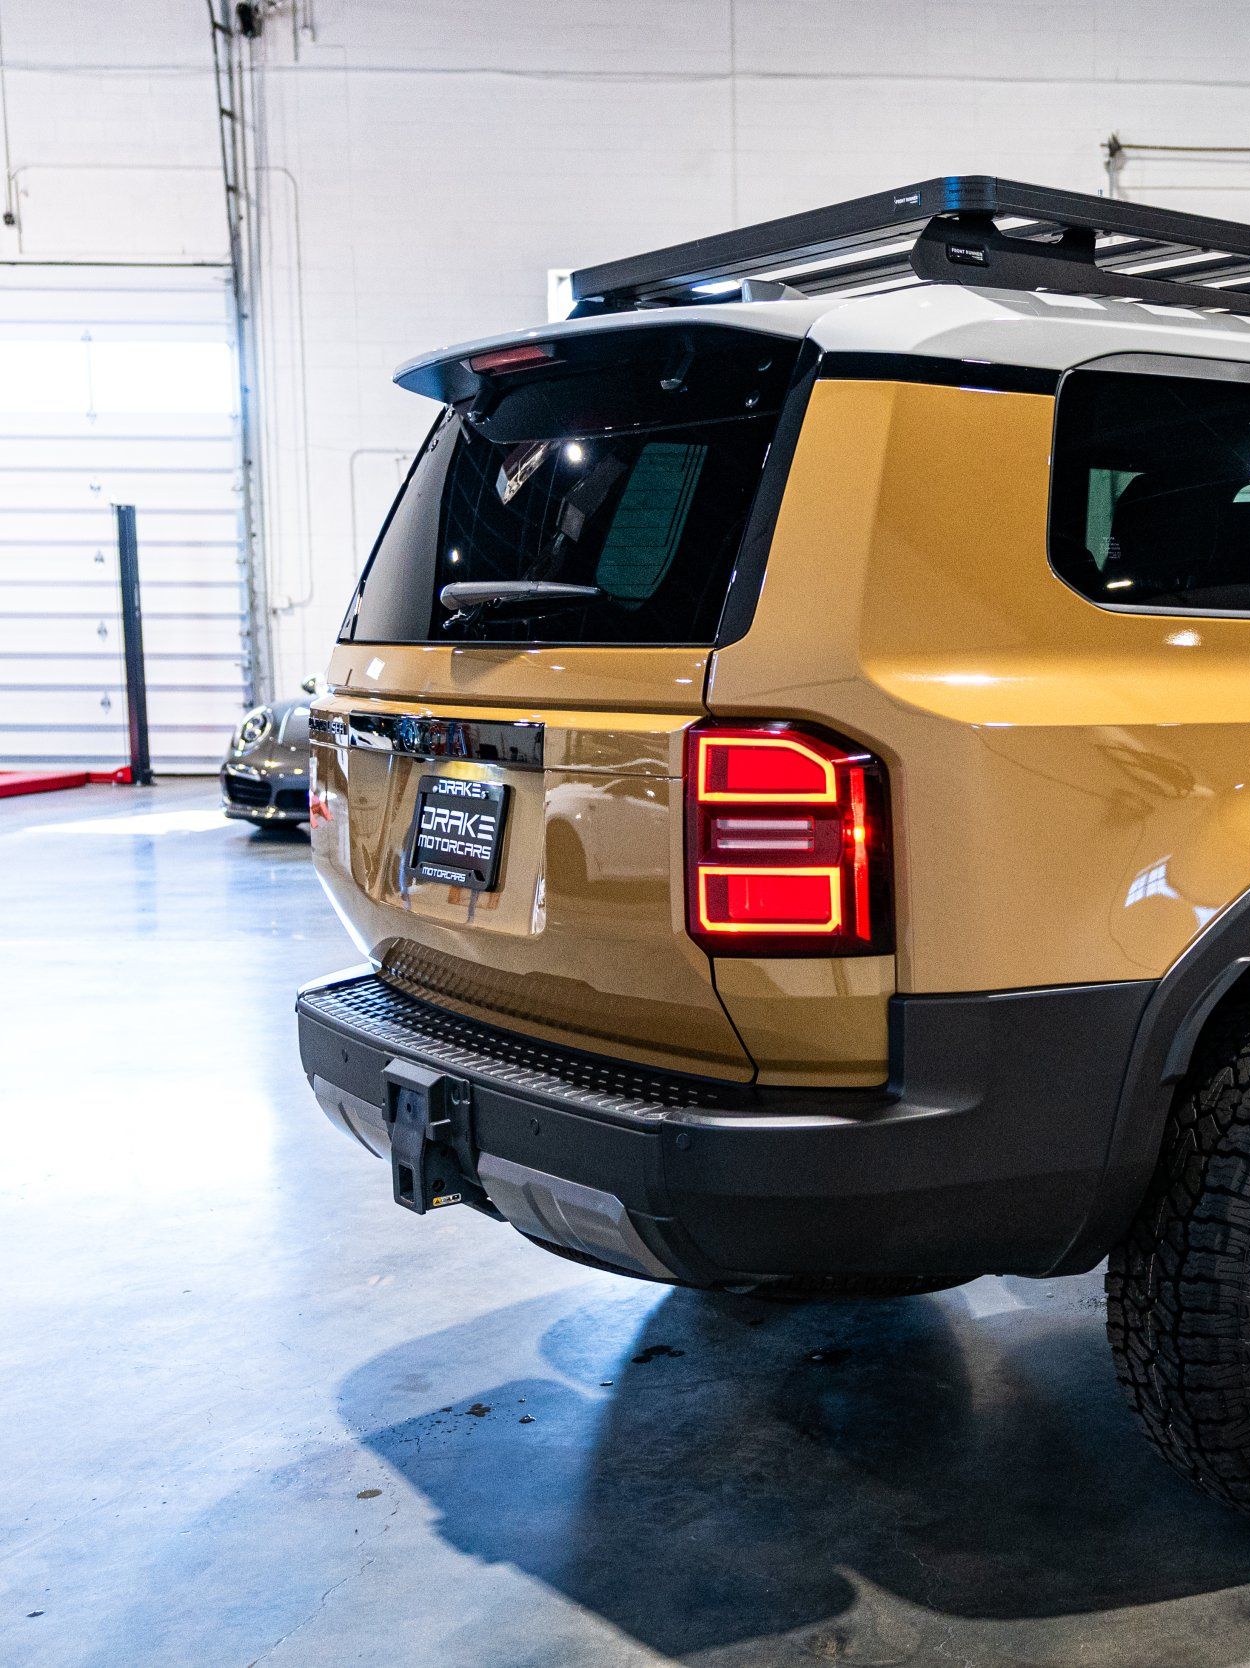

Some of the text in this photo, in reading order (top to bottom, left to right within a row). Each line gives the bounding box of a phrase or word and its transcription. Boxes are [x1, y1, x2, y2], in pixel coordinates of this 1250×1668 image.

[438, 780, 482, 798] DRAKE
[421, 806, 496, 840] DRAKE
[418, 834, 491, 860] MOTORCARS
[422, 866, 466, 882] MOTORCARS
